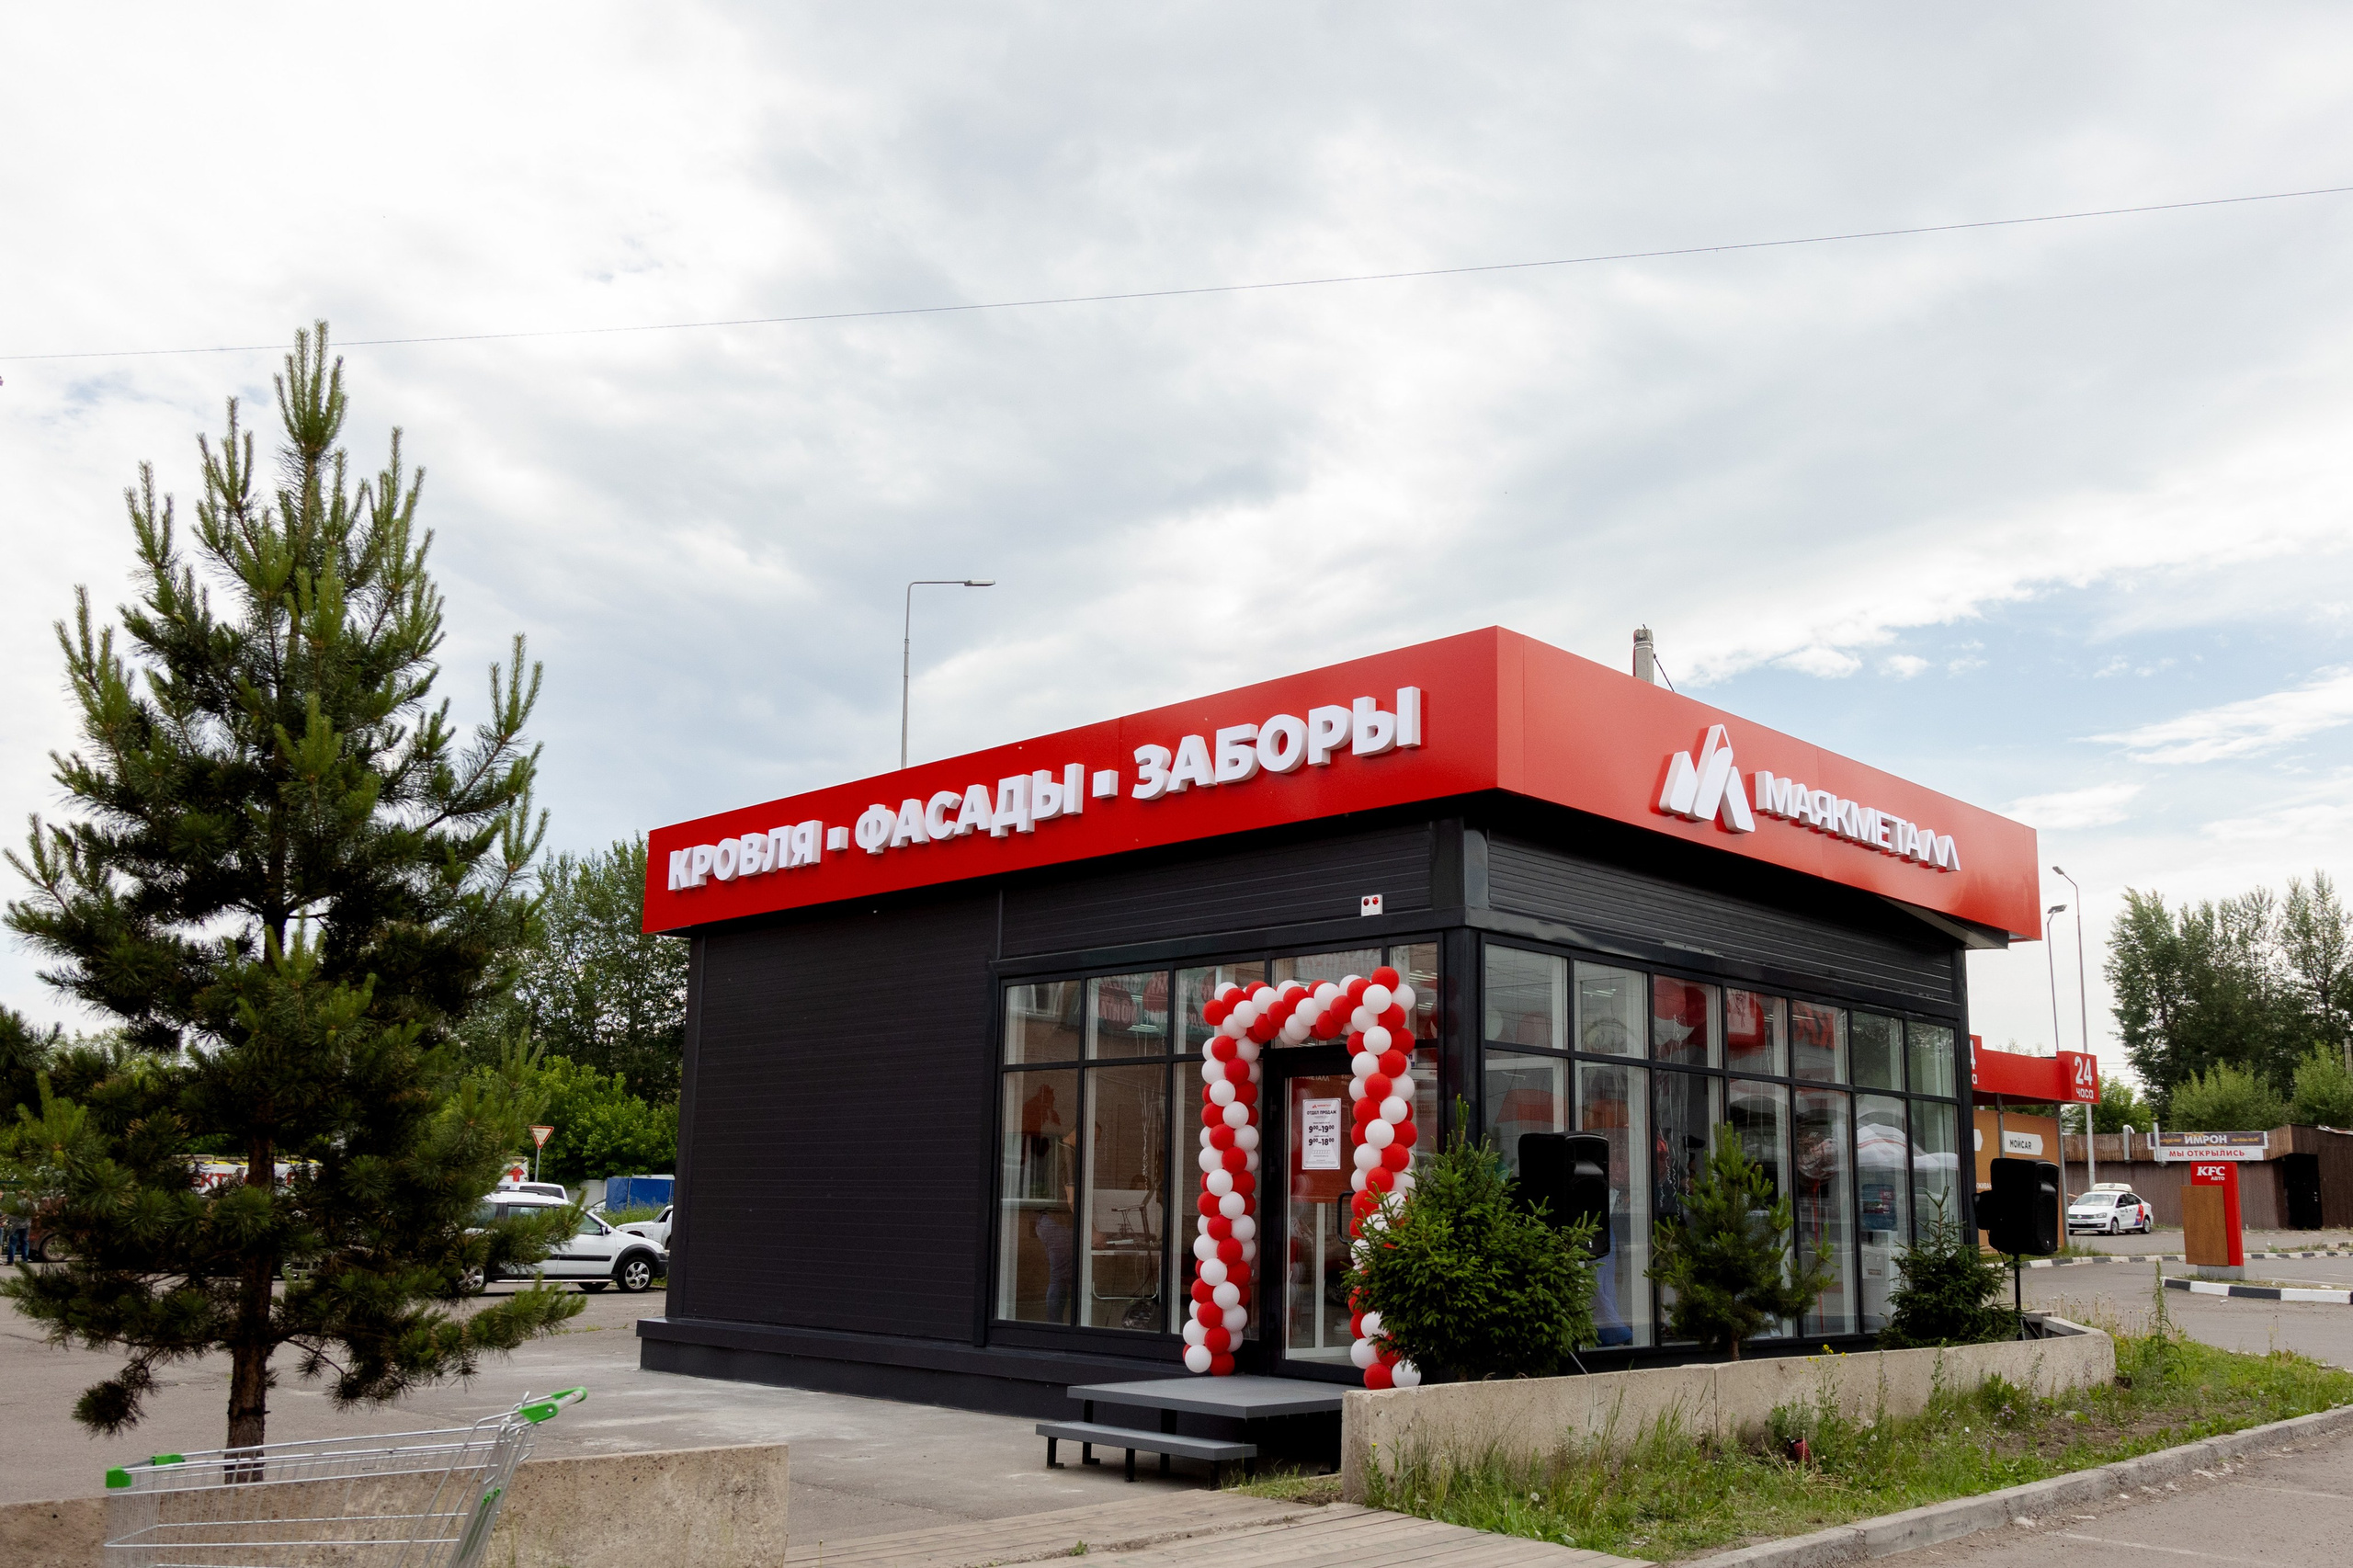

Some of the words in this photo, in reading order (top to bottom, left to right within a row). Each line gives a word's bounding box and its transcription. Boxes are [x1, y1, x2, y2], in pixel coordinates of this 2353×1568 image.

[666, 819, 823, 892] КРОВЛЯ
[854, 762, 1085, 856] ФАСАДЫ
[1132, 686, 1421, 801] ЗАБОРЫ
[1755, 770, 1961, 871] МАЯКМЕТАЛЛ
[2075, 1055, 2093, 1085] 24
[2075, 1087, 2094, 1099] часа
[2184, 1134, 2227, 1144] ИМРОН
[2188, 1149, 2245, 1157] ОТКРЫЛИСЬ
[2196, 1165, 2225, 1176] KFC
